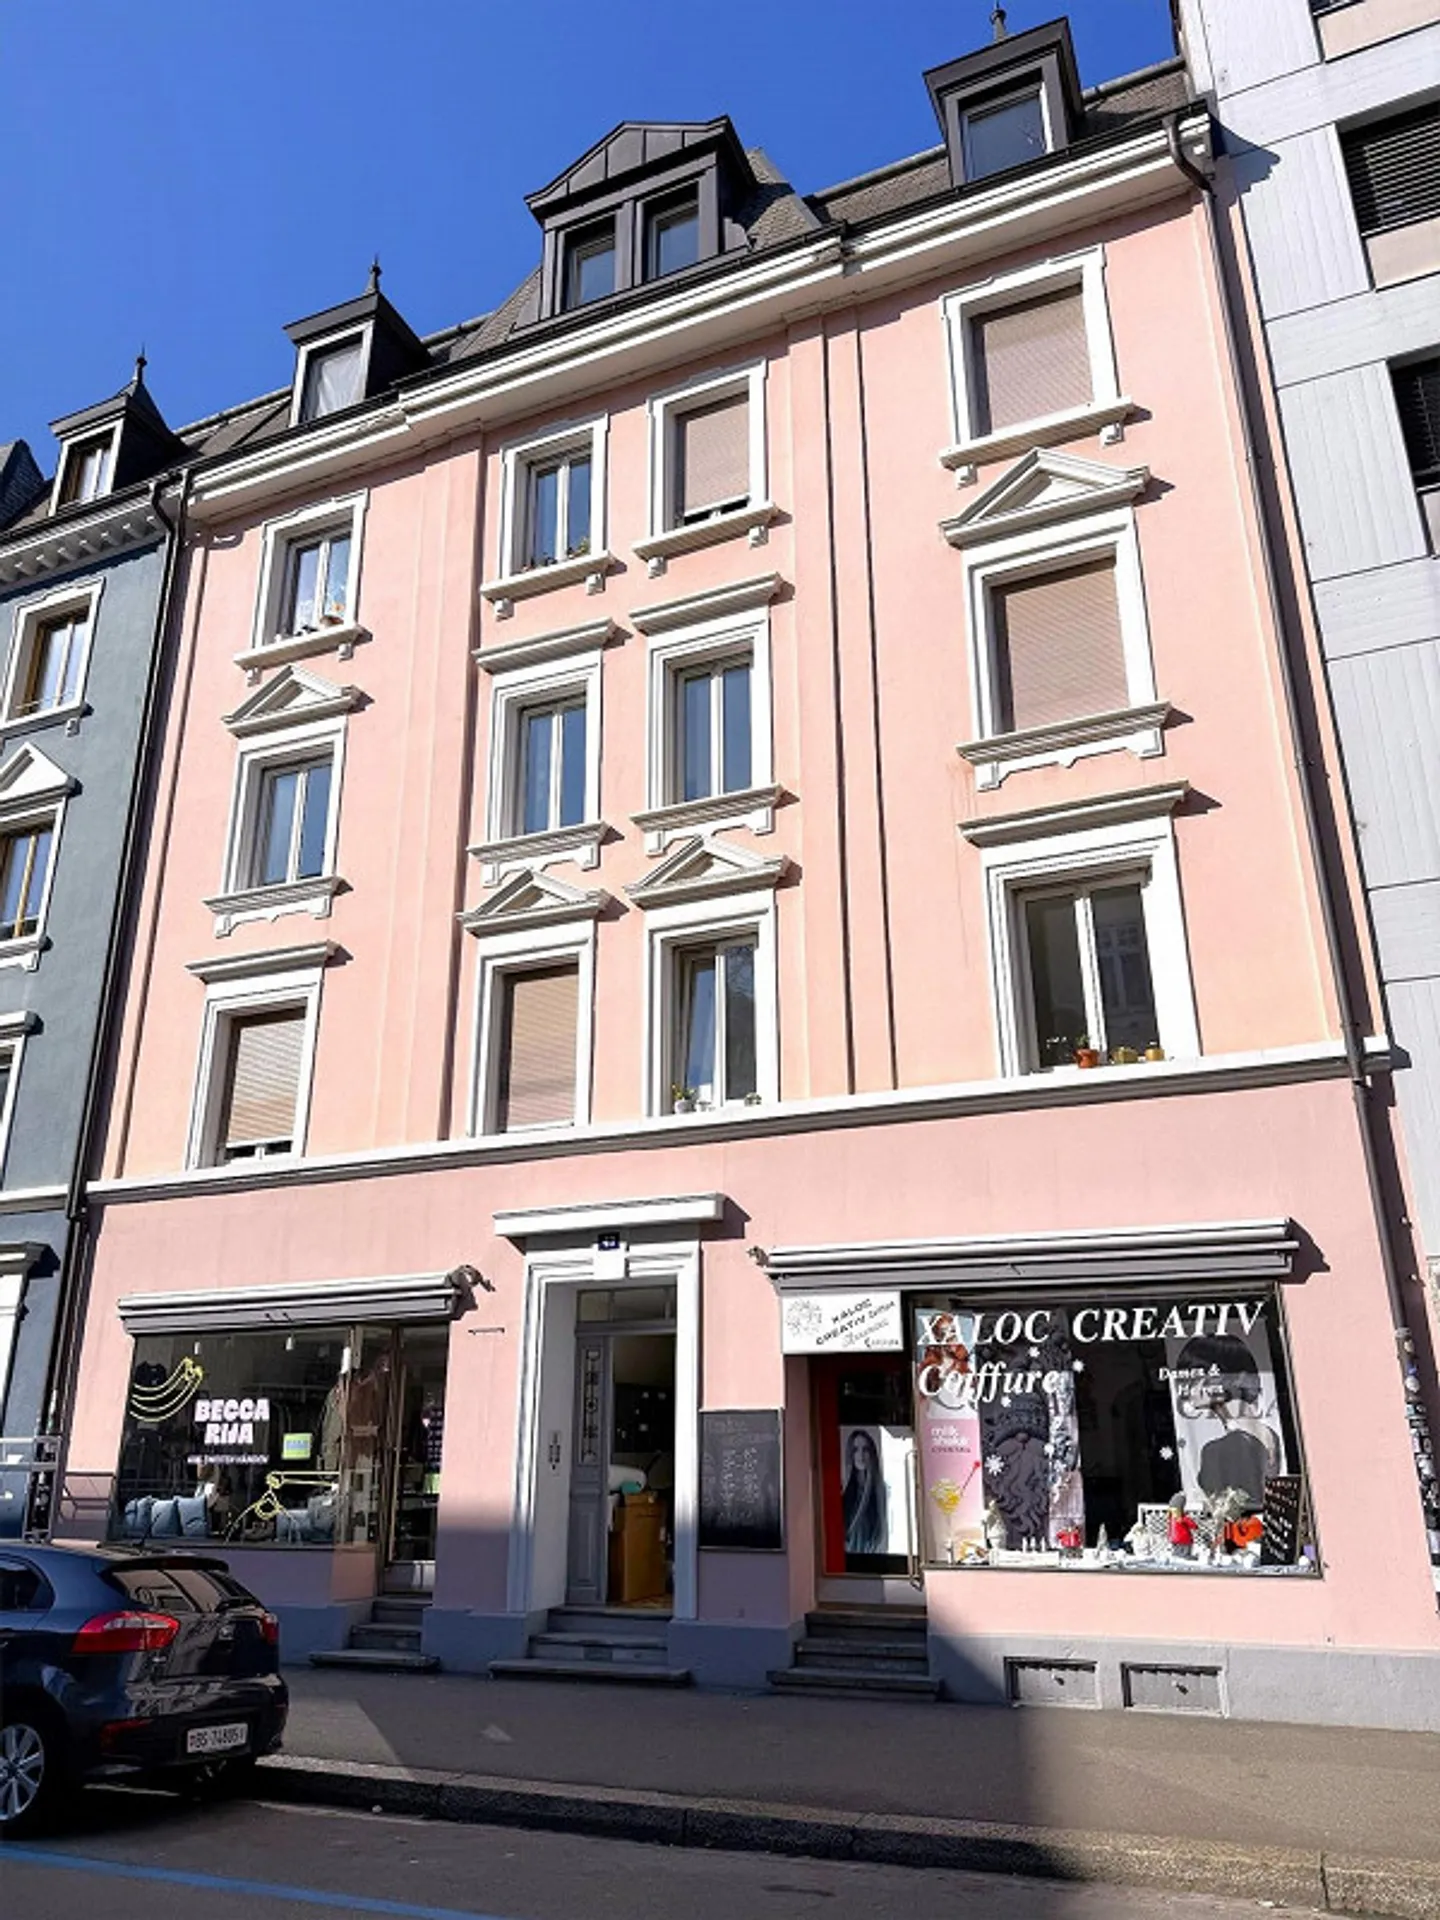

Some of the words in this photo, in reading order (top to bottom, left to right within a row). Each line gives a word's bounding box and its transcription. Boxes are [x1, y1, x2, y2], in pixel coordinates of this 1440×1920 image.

[917, 1309, 1051, 1345] XALOC
[1072, 1302, 1264, 1343] CREATIV
[918, 1361, 1060, 1404] Coiffure
[195, 1398, 270, 1421] BECCA
